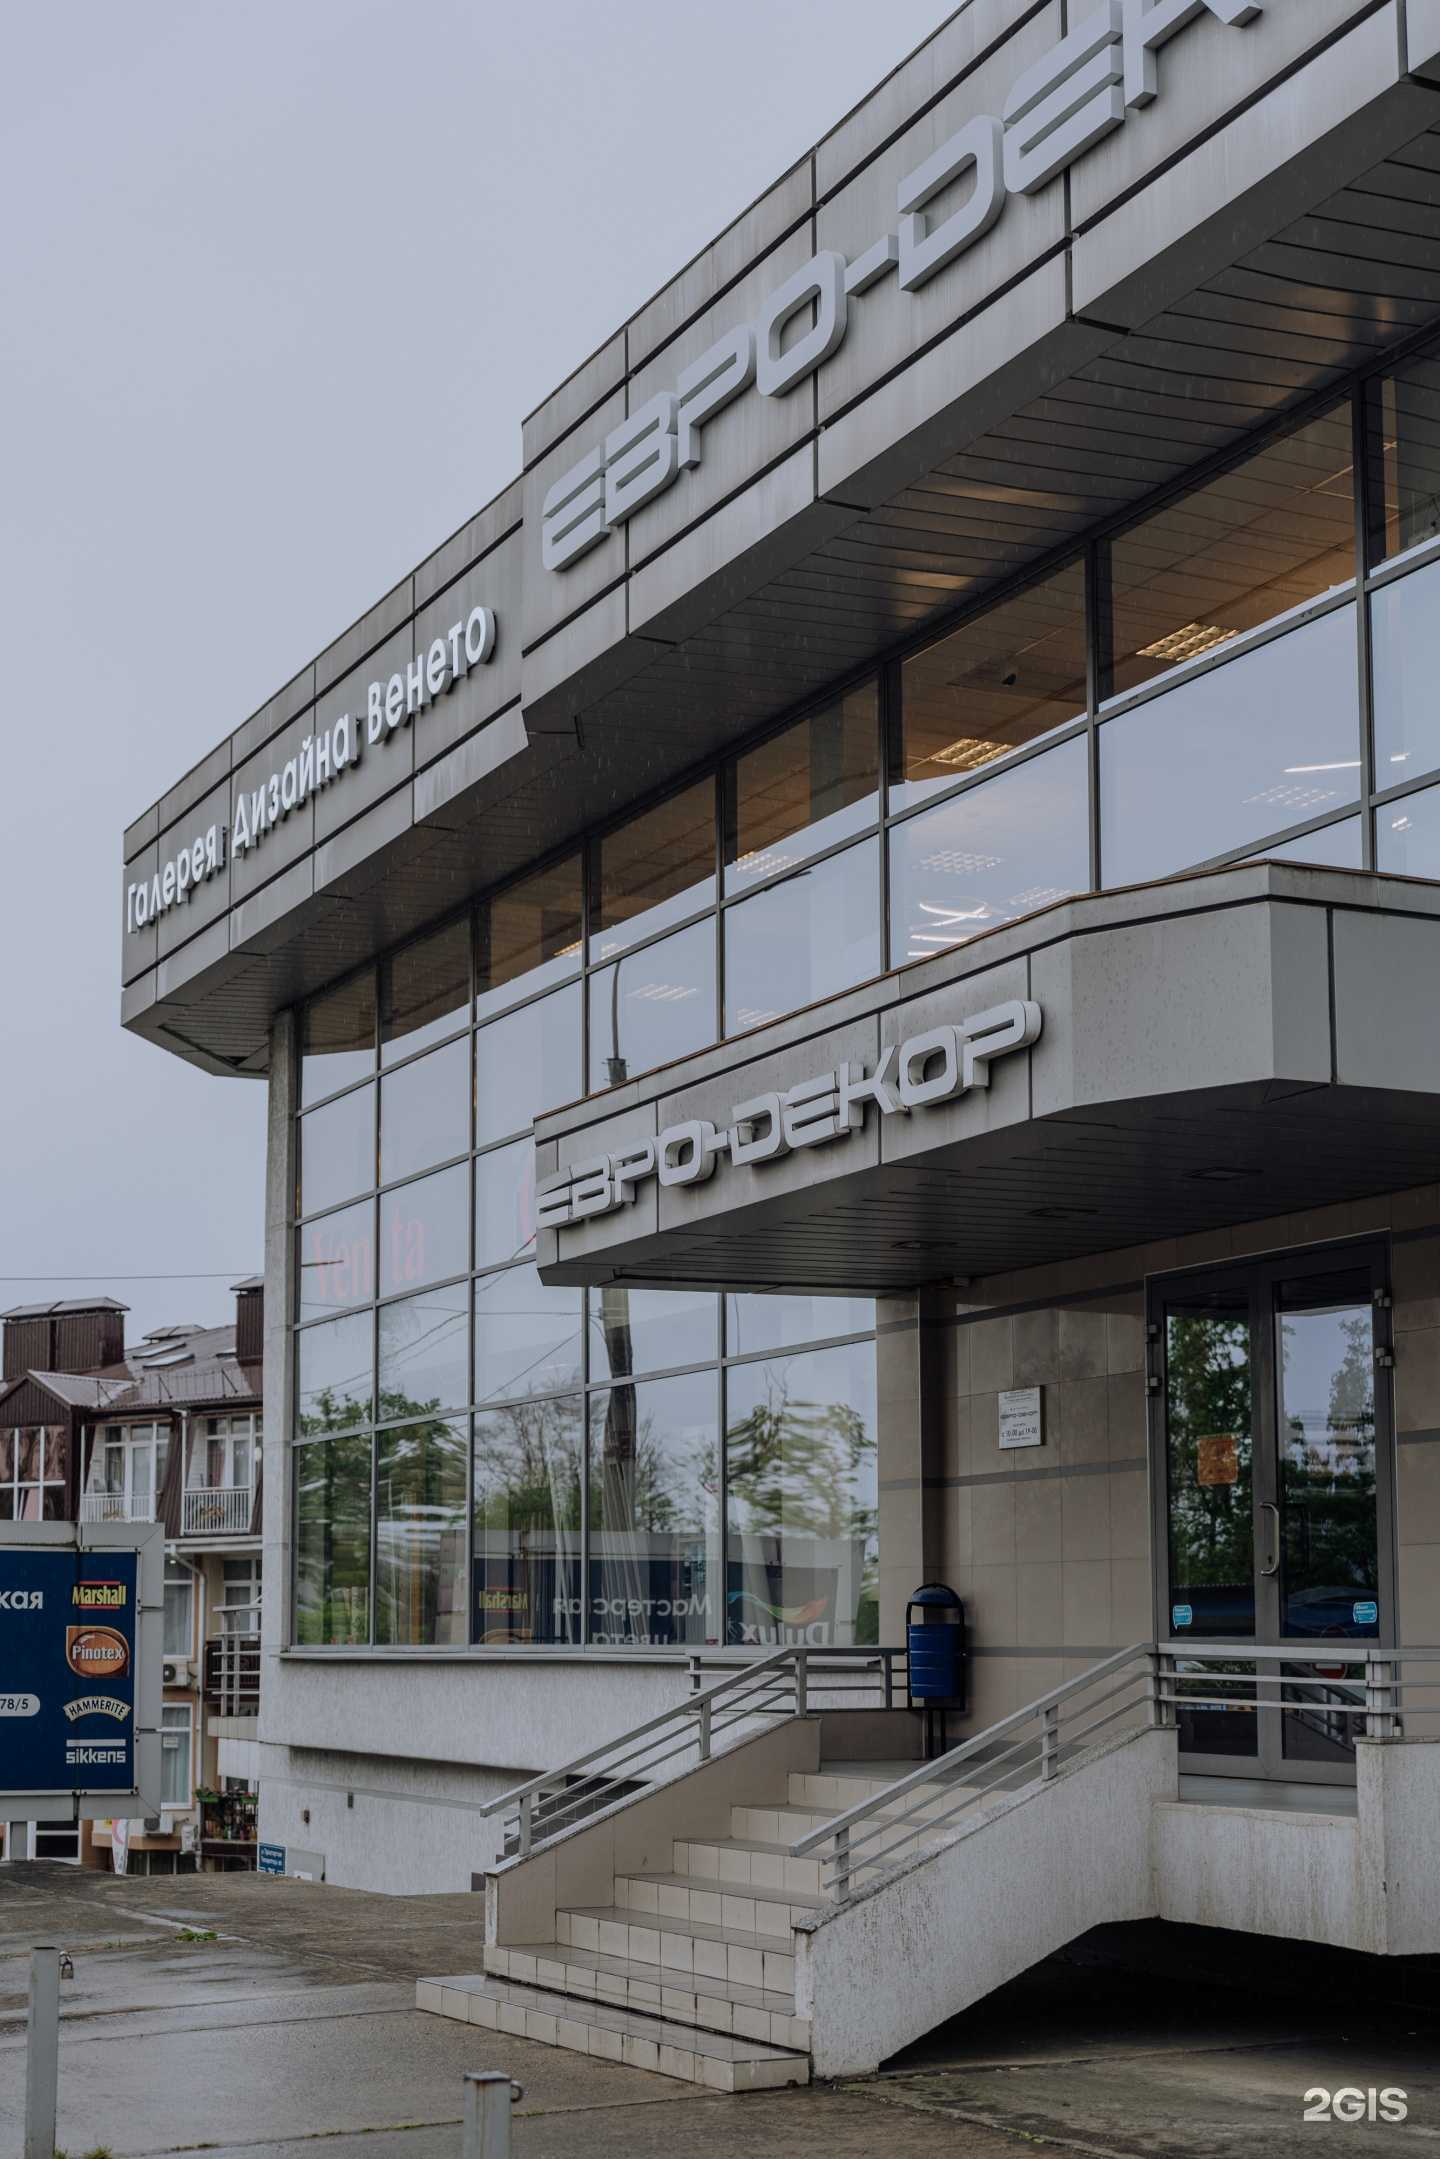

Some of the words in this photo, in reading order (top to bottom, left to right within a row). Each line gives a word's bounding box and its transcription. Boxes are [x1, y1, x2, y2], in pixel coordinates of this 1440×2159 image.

[127, 824, 227, 934] Галерея
[231, 712, 359, 859] Дизайна
[367, 606, 497, 745] Венето
[72, 1585, 127, 1605] Marshall
[72, 1645, 124, 1660] Pinotex
[68, 1699, 125, 1716] HAMMERITE
[65, 1748, 126, 1764] sikkens
